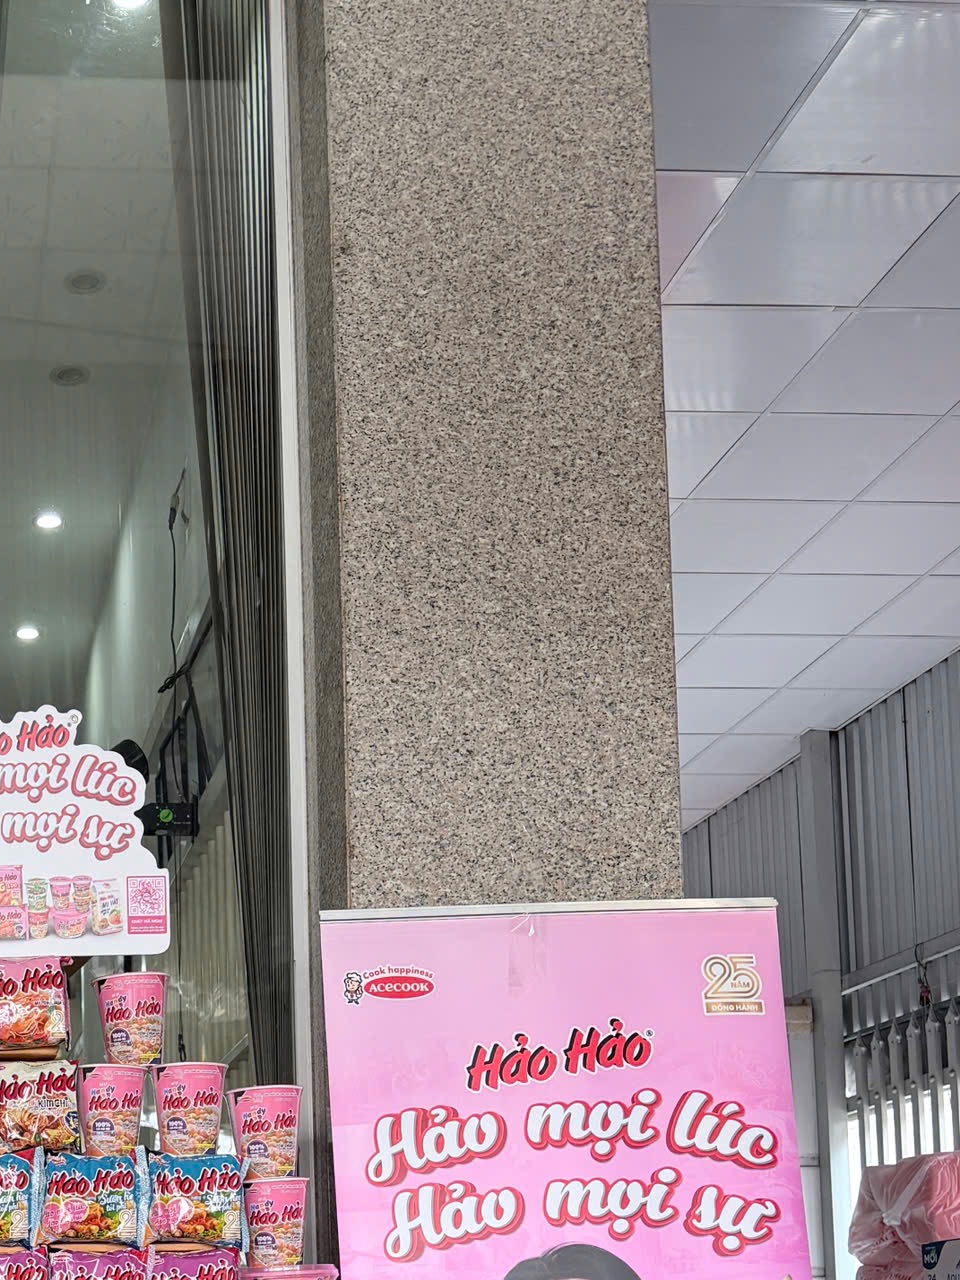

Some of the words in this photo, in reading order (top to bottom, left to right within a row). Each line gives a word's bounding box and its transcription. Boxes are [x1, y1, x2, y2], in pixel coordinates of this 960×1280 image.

[17, 714, 70, 752] Hảo
[72, 755, 136, 806] lúc
[1, 804, 79, 852] mọi
[80, 819, 134, 861] sự
[363, 967, 385, 979] Cook
[388, 966, 433, 979] happiness
[704, 955, 760, 998] 25
[730, 980, 750, 989] NĂM
[712, 1001, 734, 1012] ĐỒNG
[736, 1001, 758, 1011] HÀNH
[466, 1033, 557, 1091] Hảo
[564, 1018, 652, 1074] Hảo
[366, 1105, 506, 1185] Hảo
[525, 1088, 662, 1161] mọi
[666, 1090, 778, 1169] lúc
[47, 1168, 90, 1197] Hảo
[94, 1164, 134, 1194] Hảo
[384, 1180, 525, 1261] Hảo
[544, 1167, 682, 1240] mọi
[684, 1185, 781, 1256] sự
